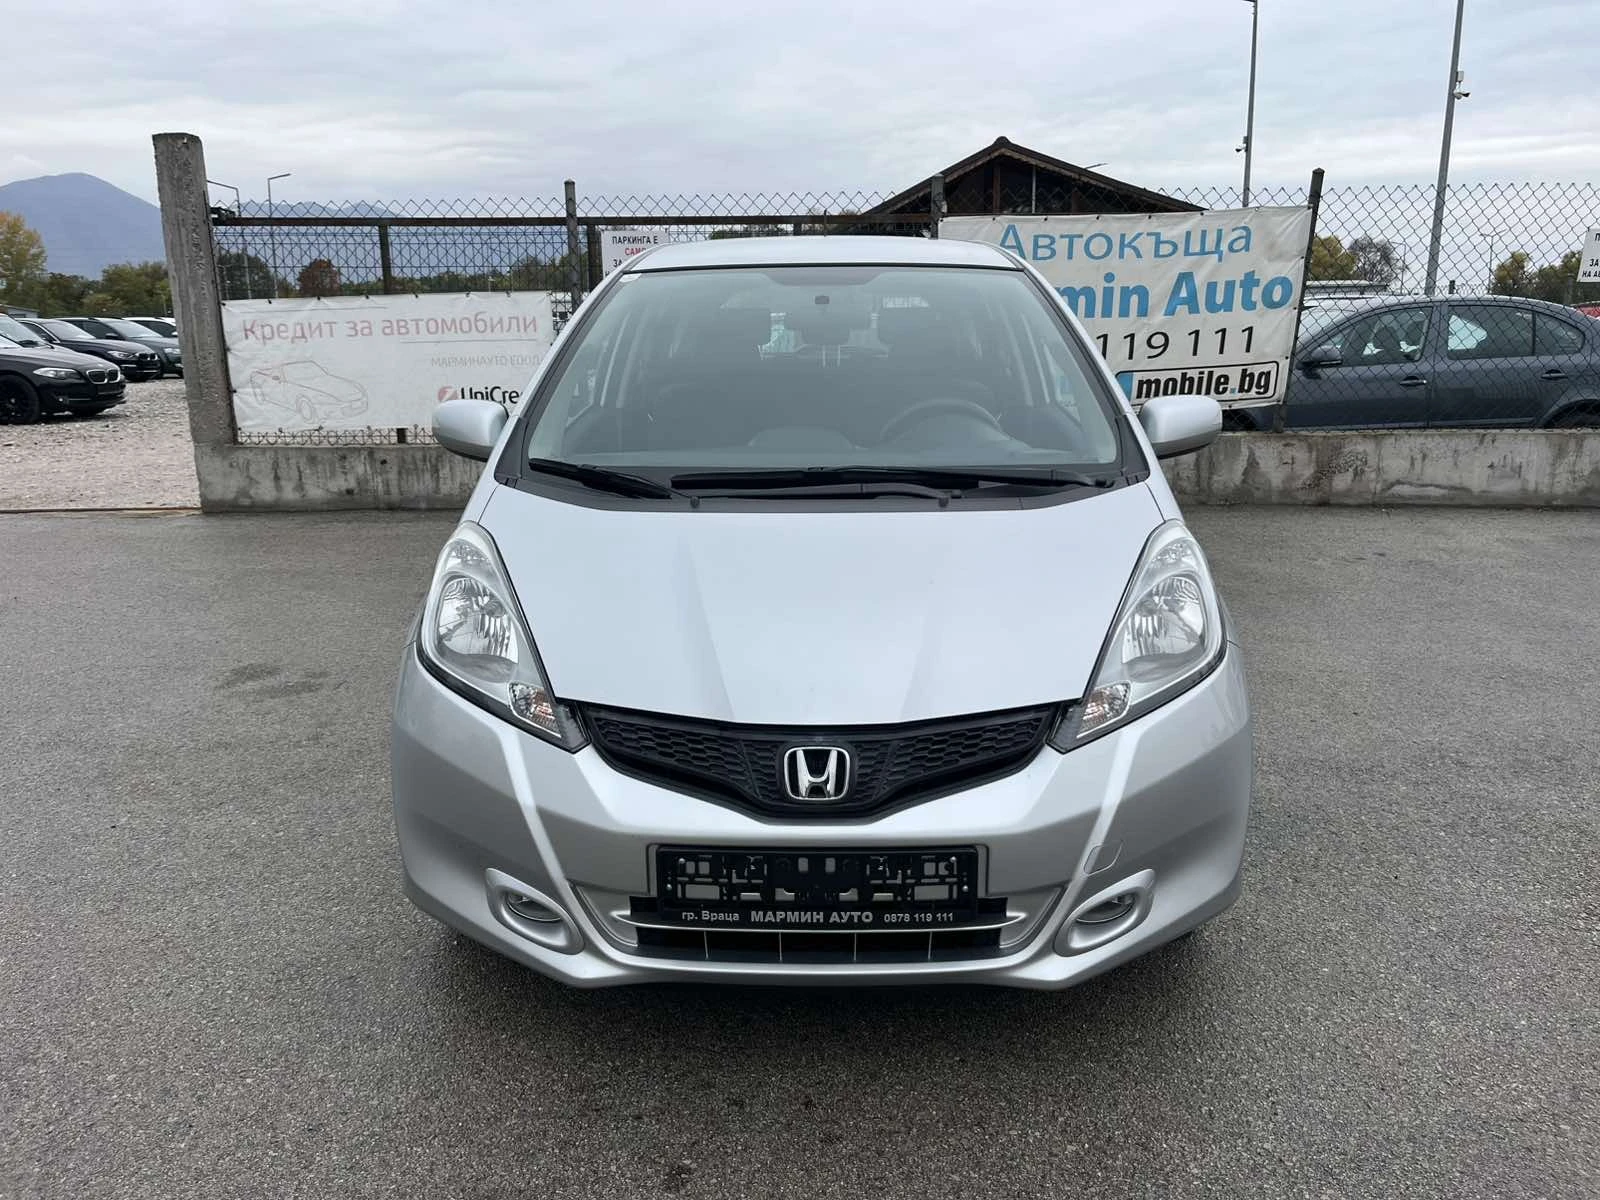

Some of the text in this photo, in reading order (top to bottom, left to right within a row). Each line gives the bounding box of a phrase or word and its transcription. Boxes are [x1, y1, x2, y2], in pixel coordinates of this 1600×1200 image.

[612, 236, 658, 244] ПАРКИНГА Е
[1000, 223, 1252, 263] Автокъща
[1163, 270, 1294, 316] Auto
[242, 310, 538, 345] Кредит за автомобили
[1187, 326, 1255, 356] 111
[461, 386, 523, 404] UniCre
[1135, 368, 1272, 399] mobile.bg
[701, 910, 740, 922] Враца
[750, 911, 824, 923] МАРМИН
[829, 911, 873, 923] АУТО
[883, 914, 910, 923] 0878
[913, 913, 933, 922] 119
[936, 912, 954, 921] 111
